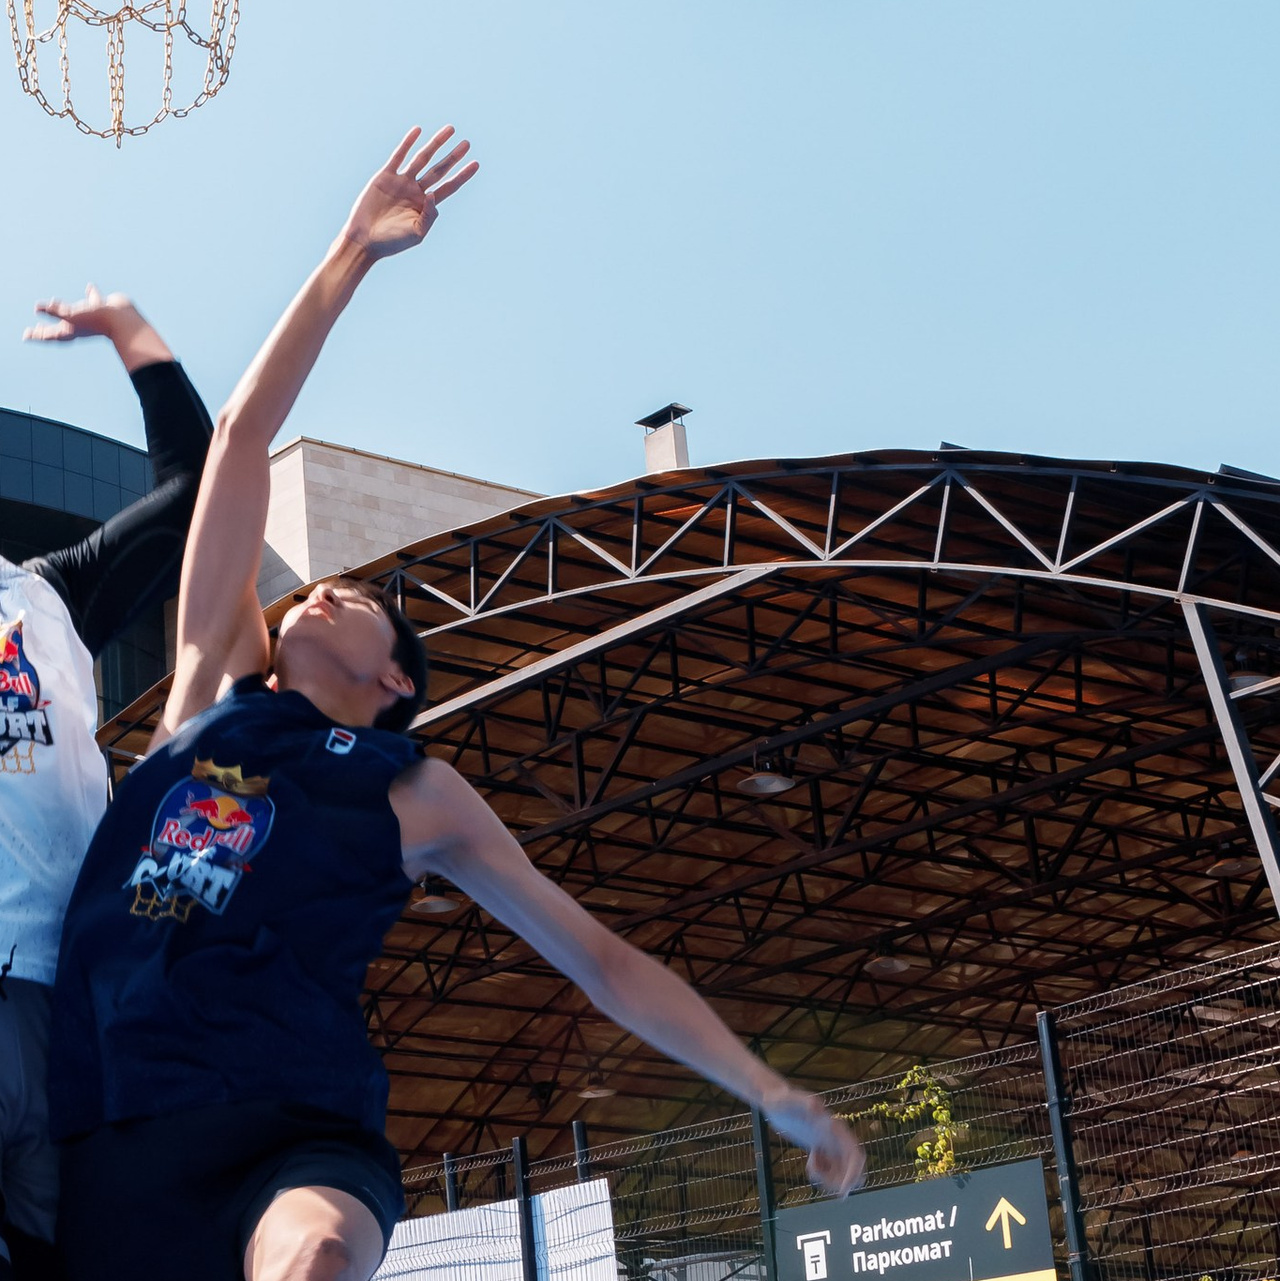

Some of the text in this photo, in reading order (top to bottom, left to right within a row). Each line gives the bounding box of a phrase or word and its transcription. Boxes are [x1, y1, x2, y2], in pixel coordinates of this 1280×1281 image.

[158, 817, 256, 856] Red ull
[850, 1210, 945, 1245] Parkomat
[852, 1240, 952, 1275] Паркомат
